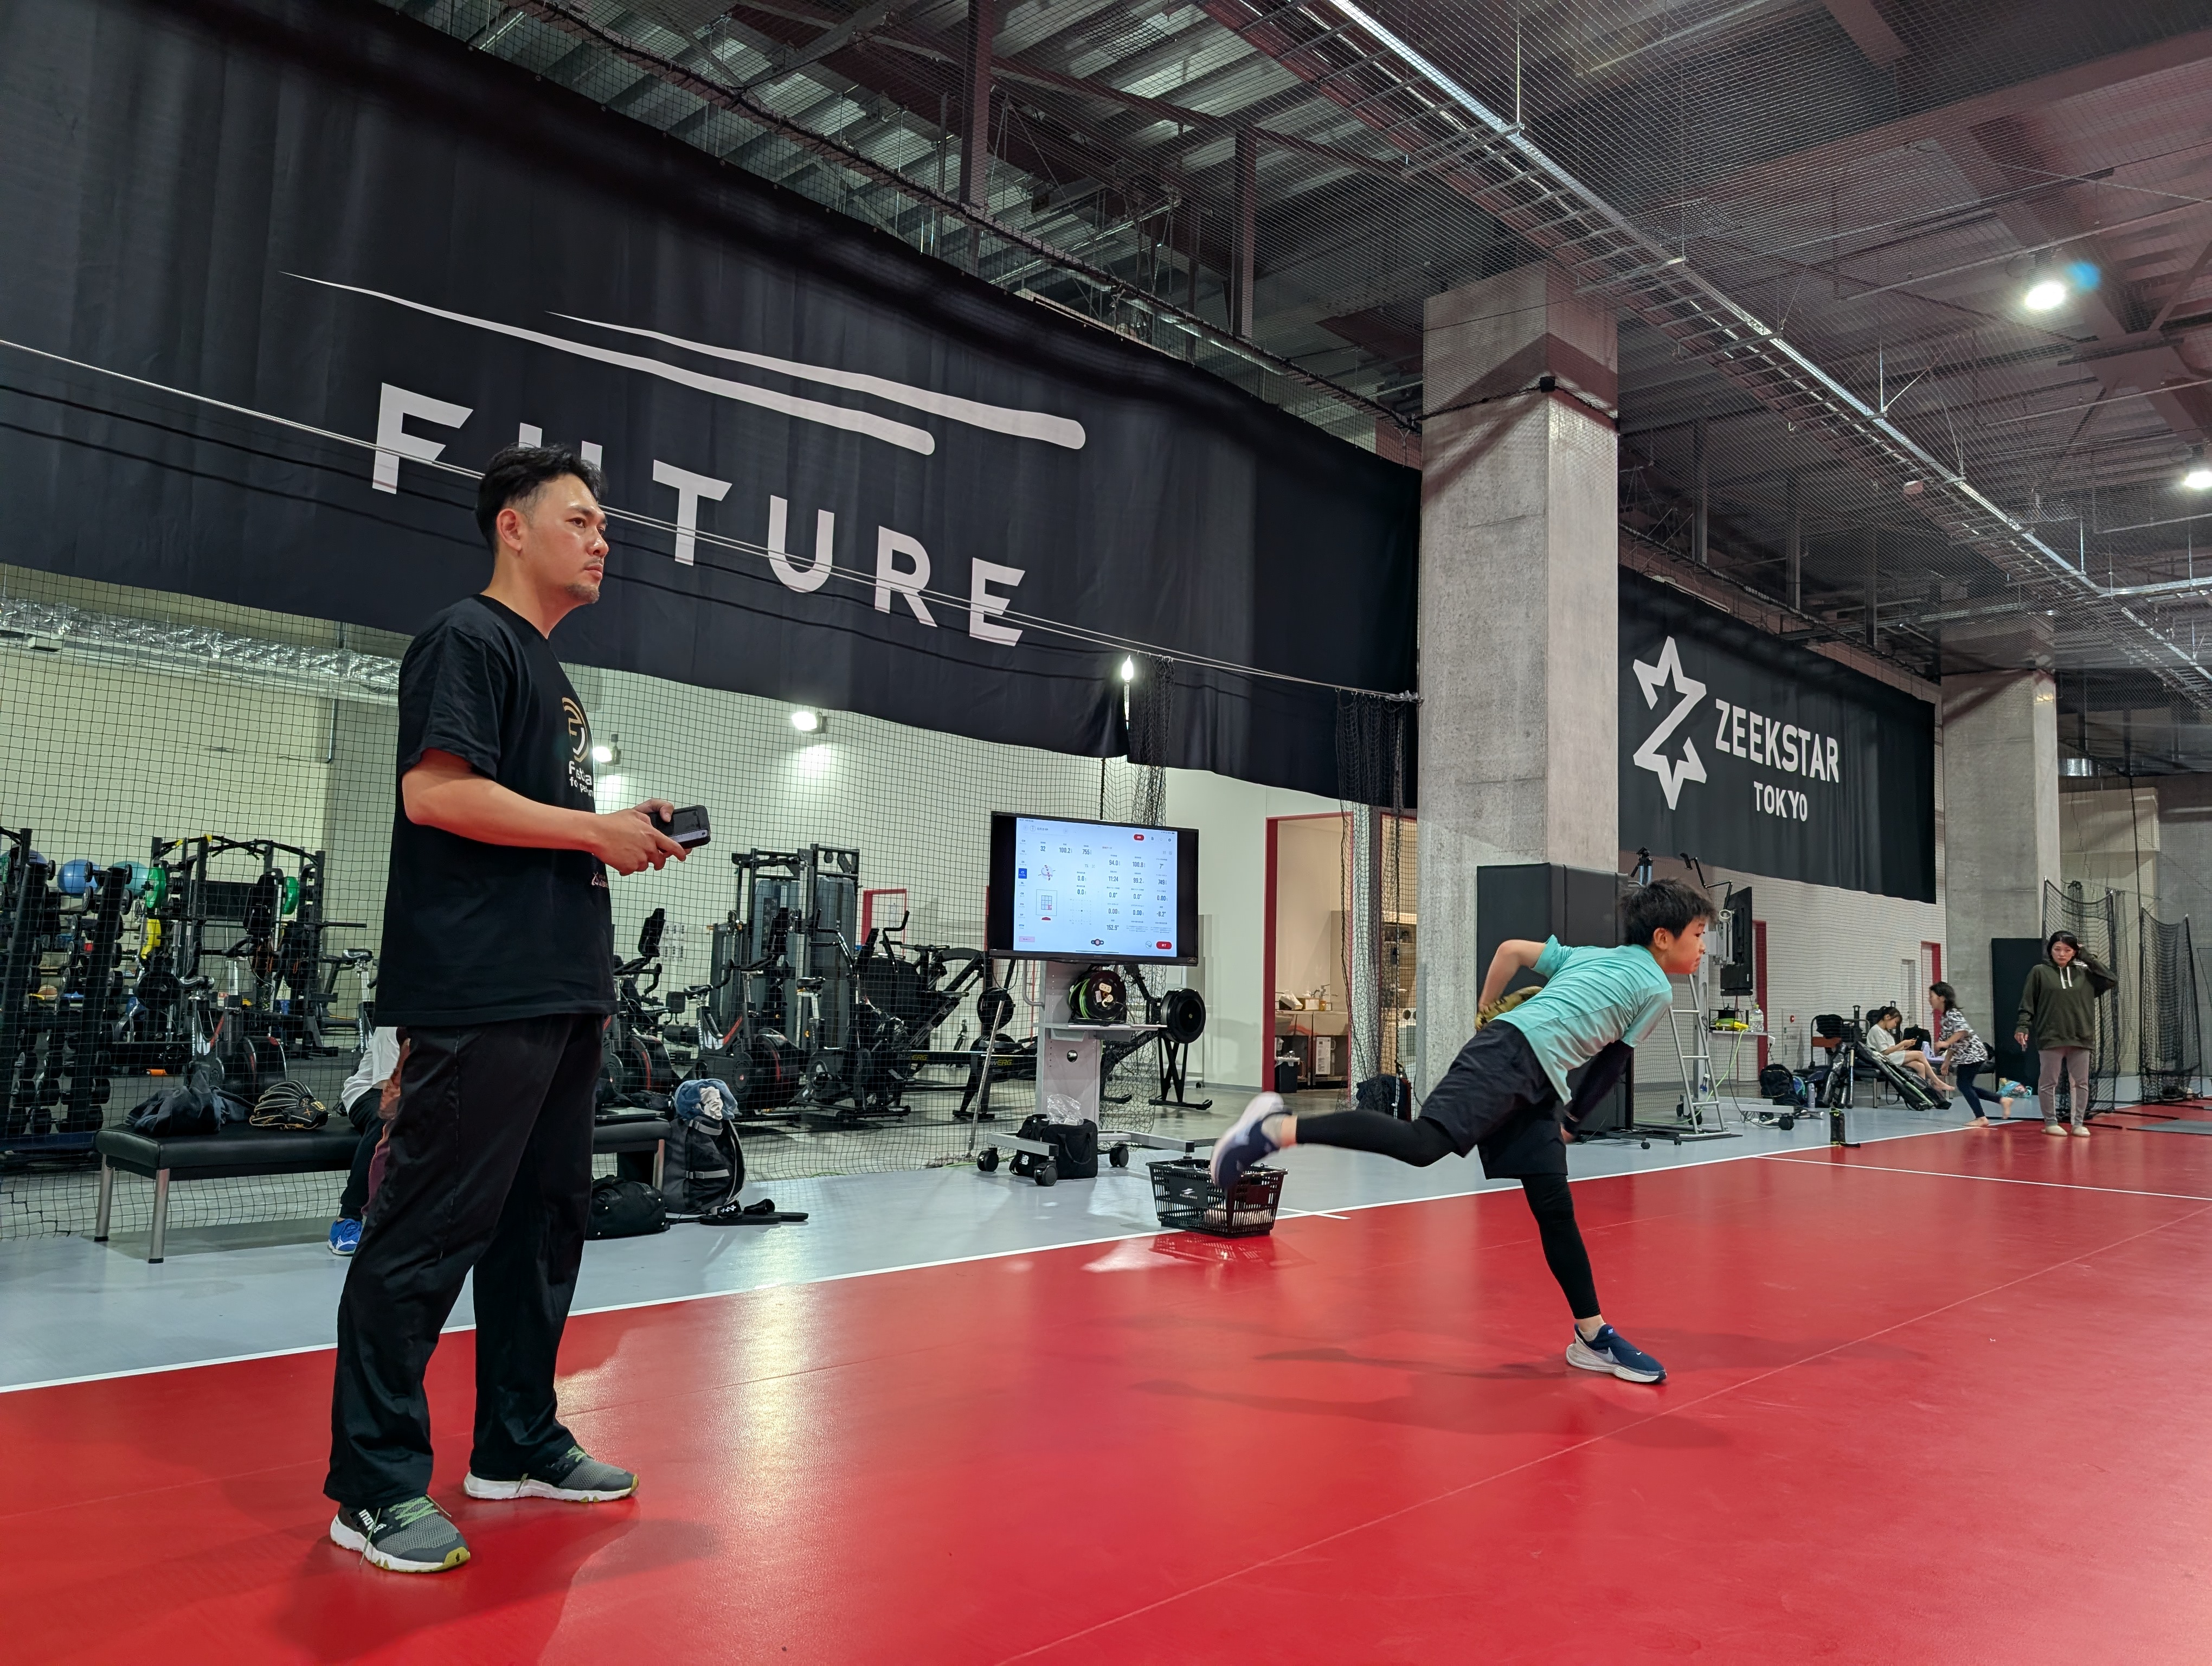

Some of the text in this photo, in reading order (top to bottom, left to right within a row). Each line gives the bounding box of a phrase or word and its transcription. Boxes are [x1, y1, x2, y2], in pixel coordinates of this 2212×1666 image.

[372, 382, 1026, 646] FTURE
[1715, 699, 1839, 783] ZEEKSTAR
[1754, 781, 1808, 822] TOKYO
